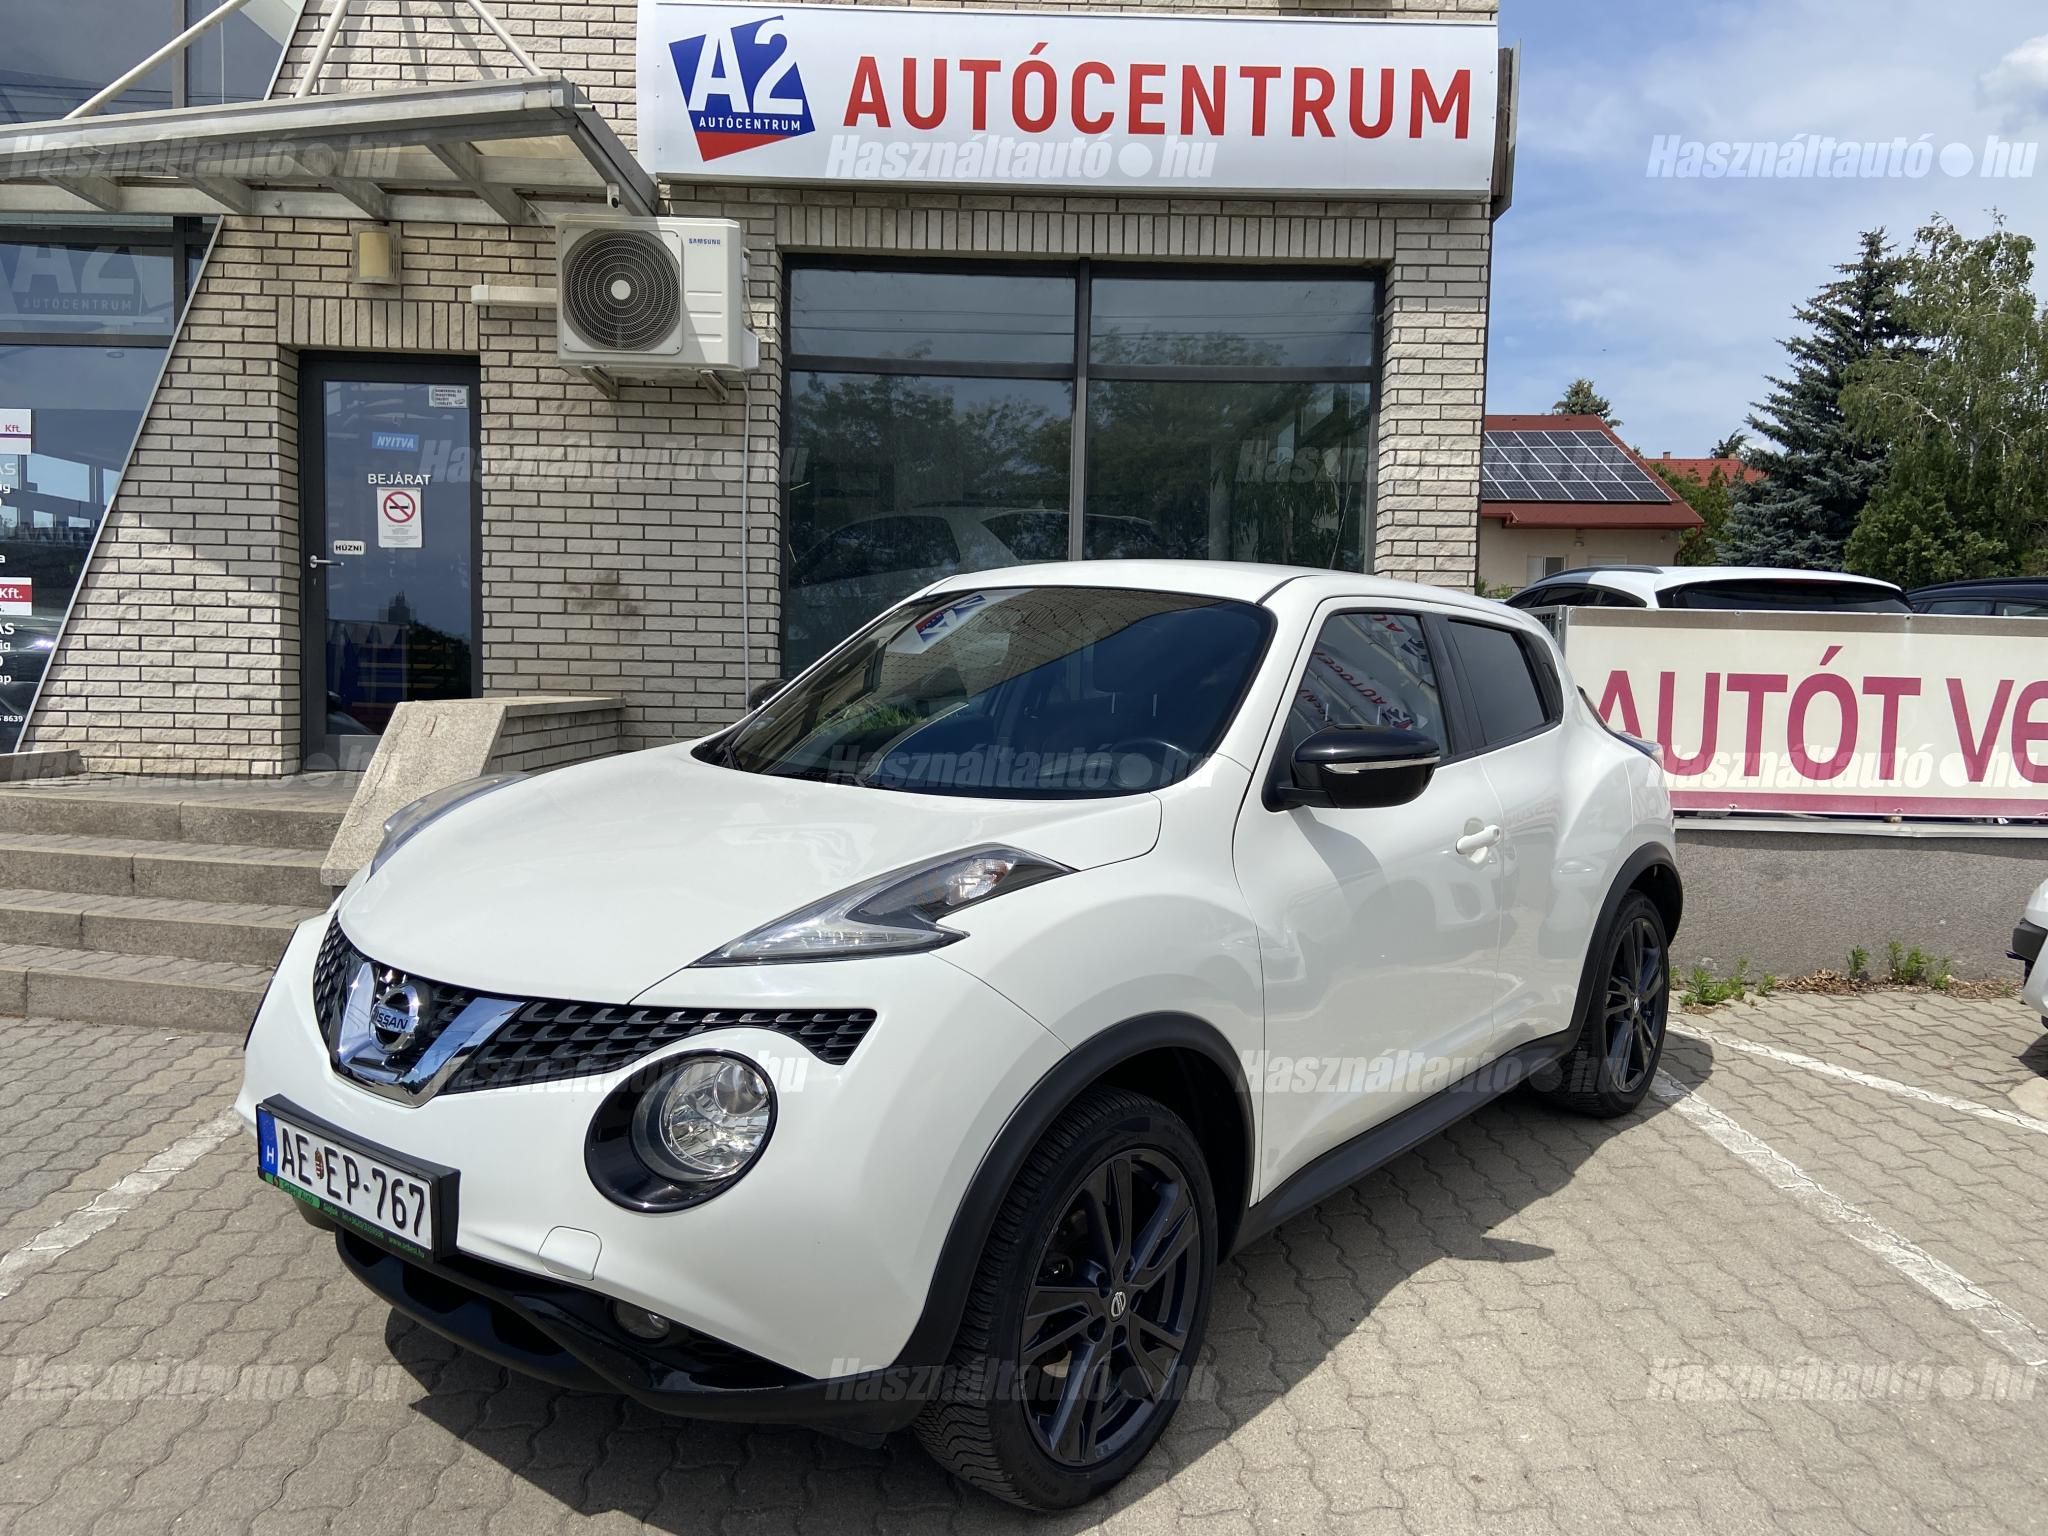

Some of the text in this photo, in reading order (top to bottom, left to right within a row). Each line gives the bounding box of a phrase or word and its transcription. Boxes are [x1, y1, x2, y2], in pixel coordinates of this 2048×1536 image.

[688, 19, 803, 115] A2
[843, 42, 1470, 139] AUTÓCENTRUM
[699, 115, 800, 131] AUTÓCENTRUM
[376, 435, 415, 449] NYITVA
[367, 472, 431, 486] BEJÁRAT
[335, 543, 363, 553] HÚZNI
[1598, 645, 1922, 782] AUTÓT
[266, 1145, 275, 1164] H
[281, 1127, 313, 1186] AE
